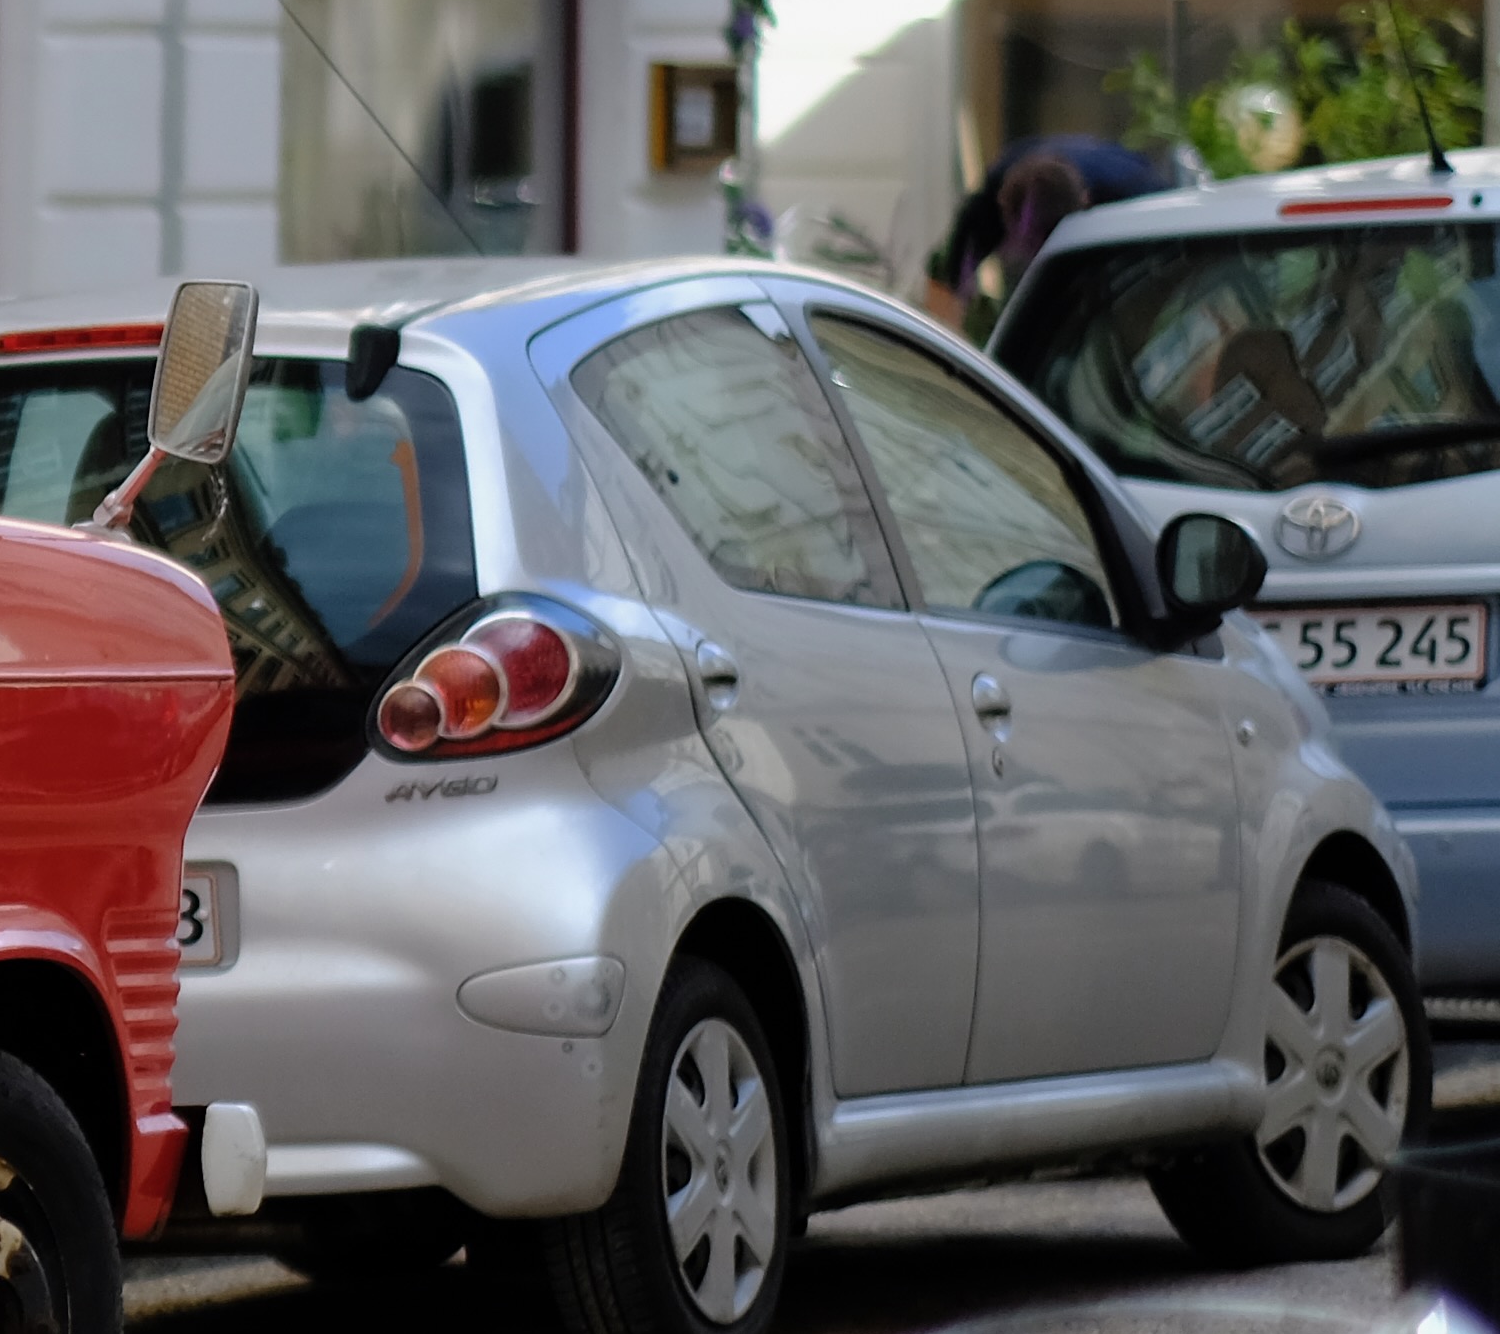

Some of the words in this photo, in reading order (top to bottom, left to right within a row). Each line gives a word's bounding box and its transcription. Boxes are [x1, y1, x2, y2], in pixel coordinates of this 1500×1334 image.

[1298, 621, 1357, 669] 55
[1376, 616, 1471, 667] 245
[384, 774, 499, 803] AYGO
